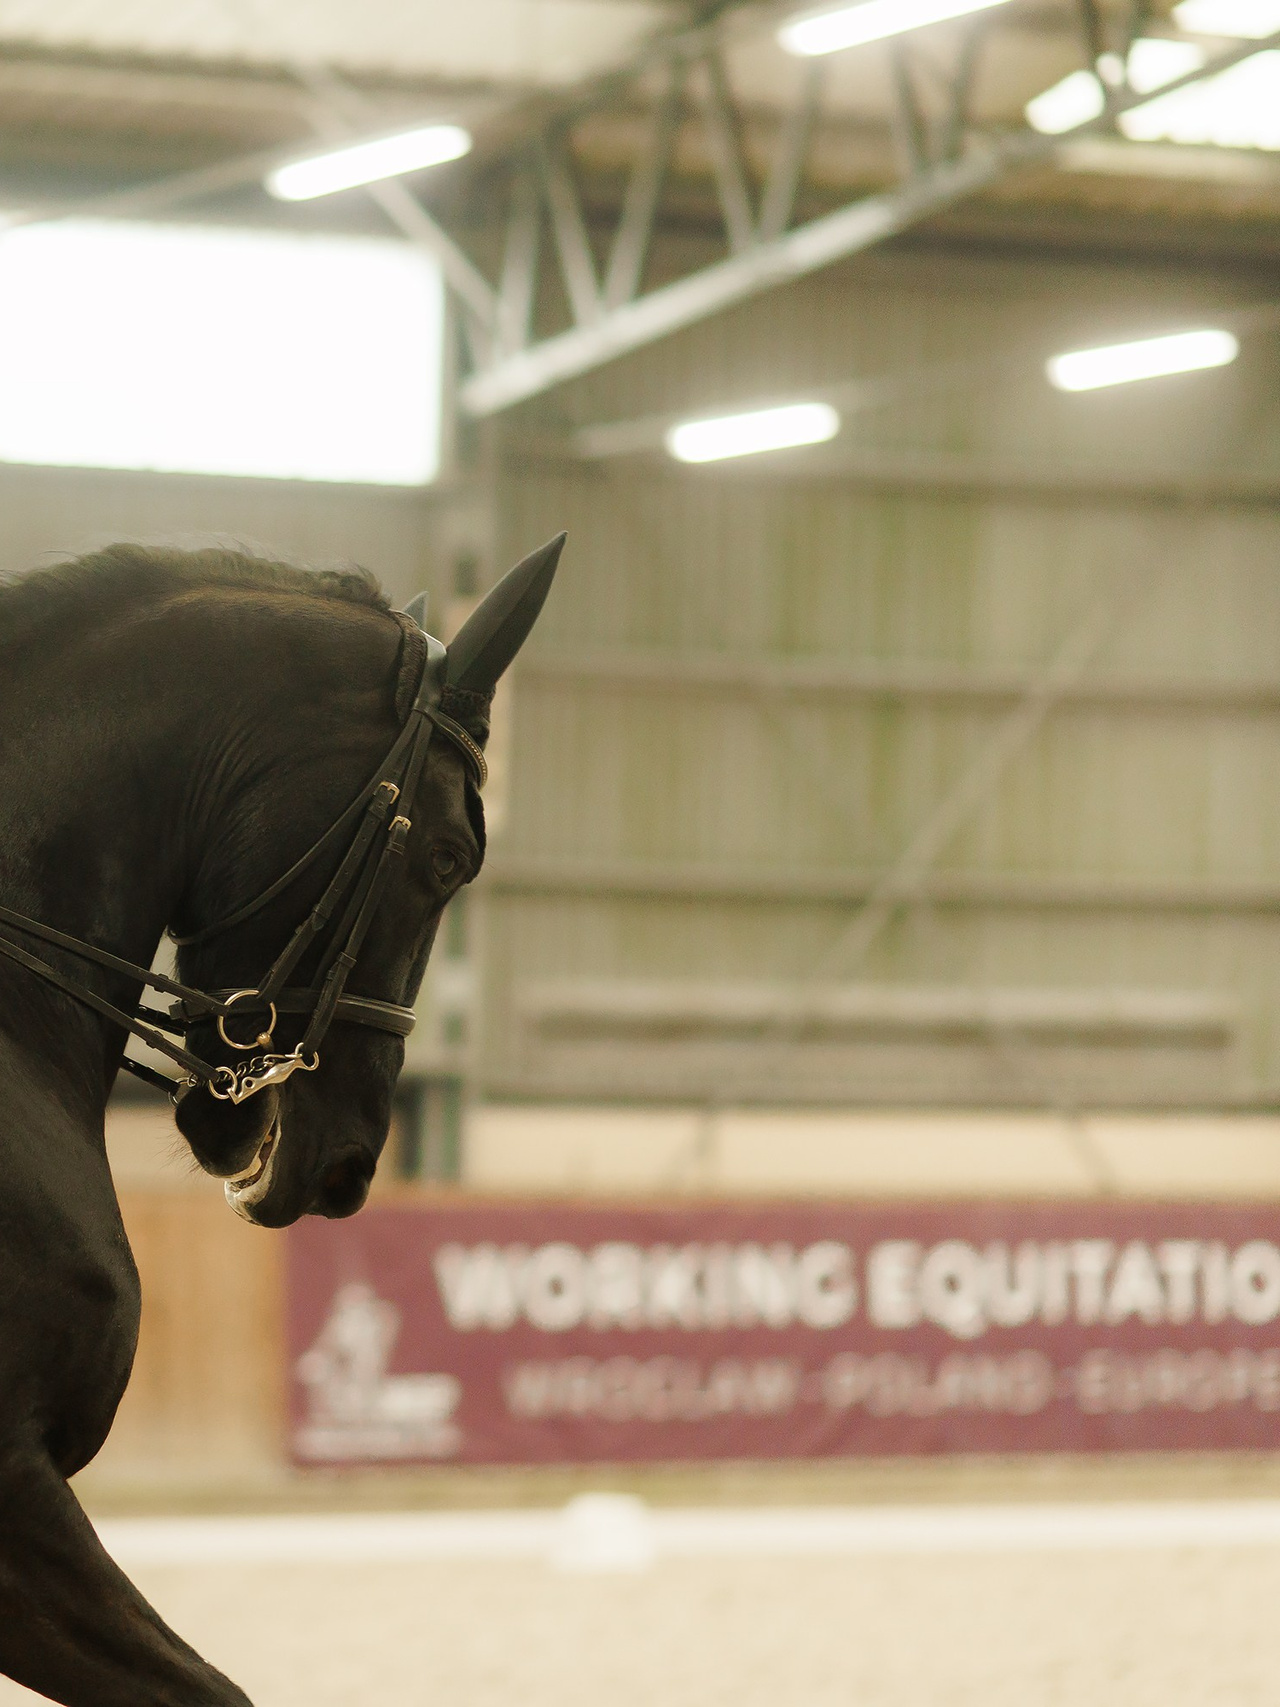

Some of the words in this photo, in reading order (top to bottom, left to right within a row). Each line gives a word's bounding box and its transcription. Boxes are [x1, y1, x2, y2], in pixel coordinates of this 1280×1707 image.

[433, 1240, 857, 1332] WORKING
[866, 1238, 1280, 1341] EQUITATIO
[821, 1348, 1052, 1418] POLAND
